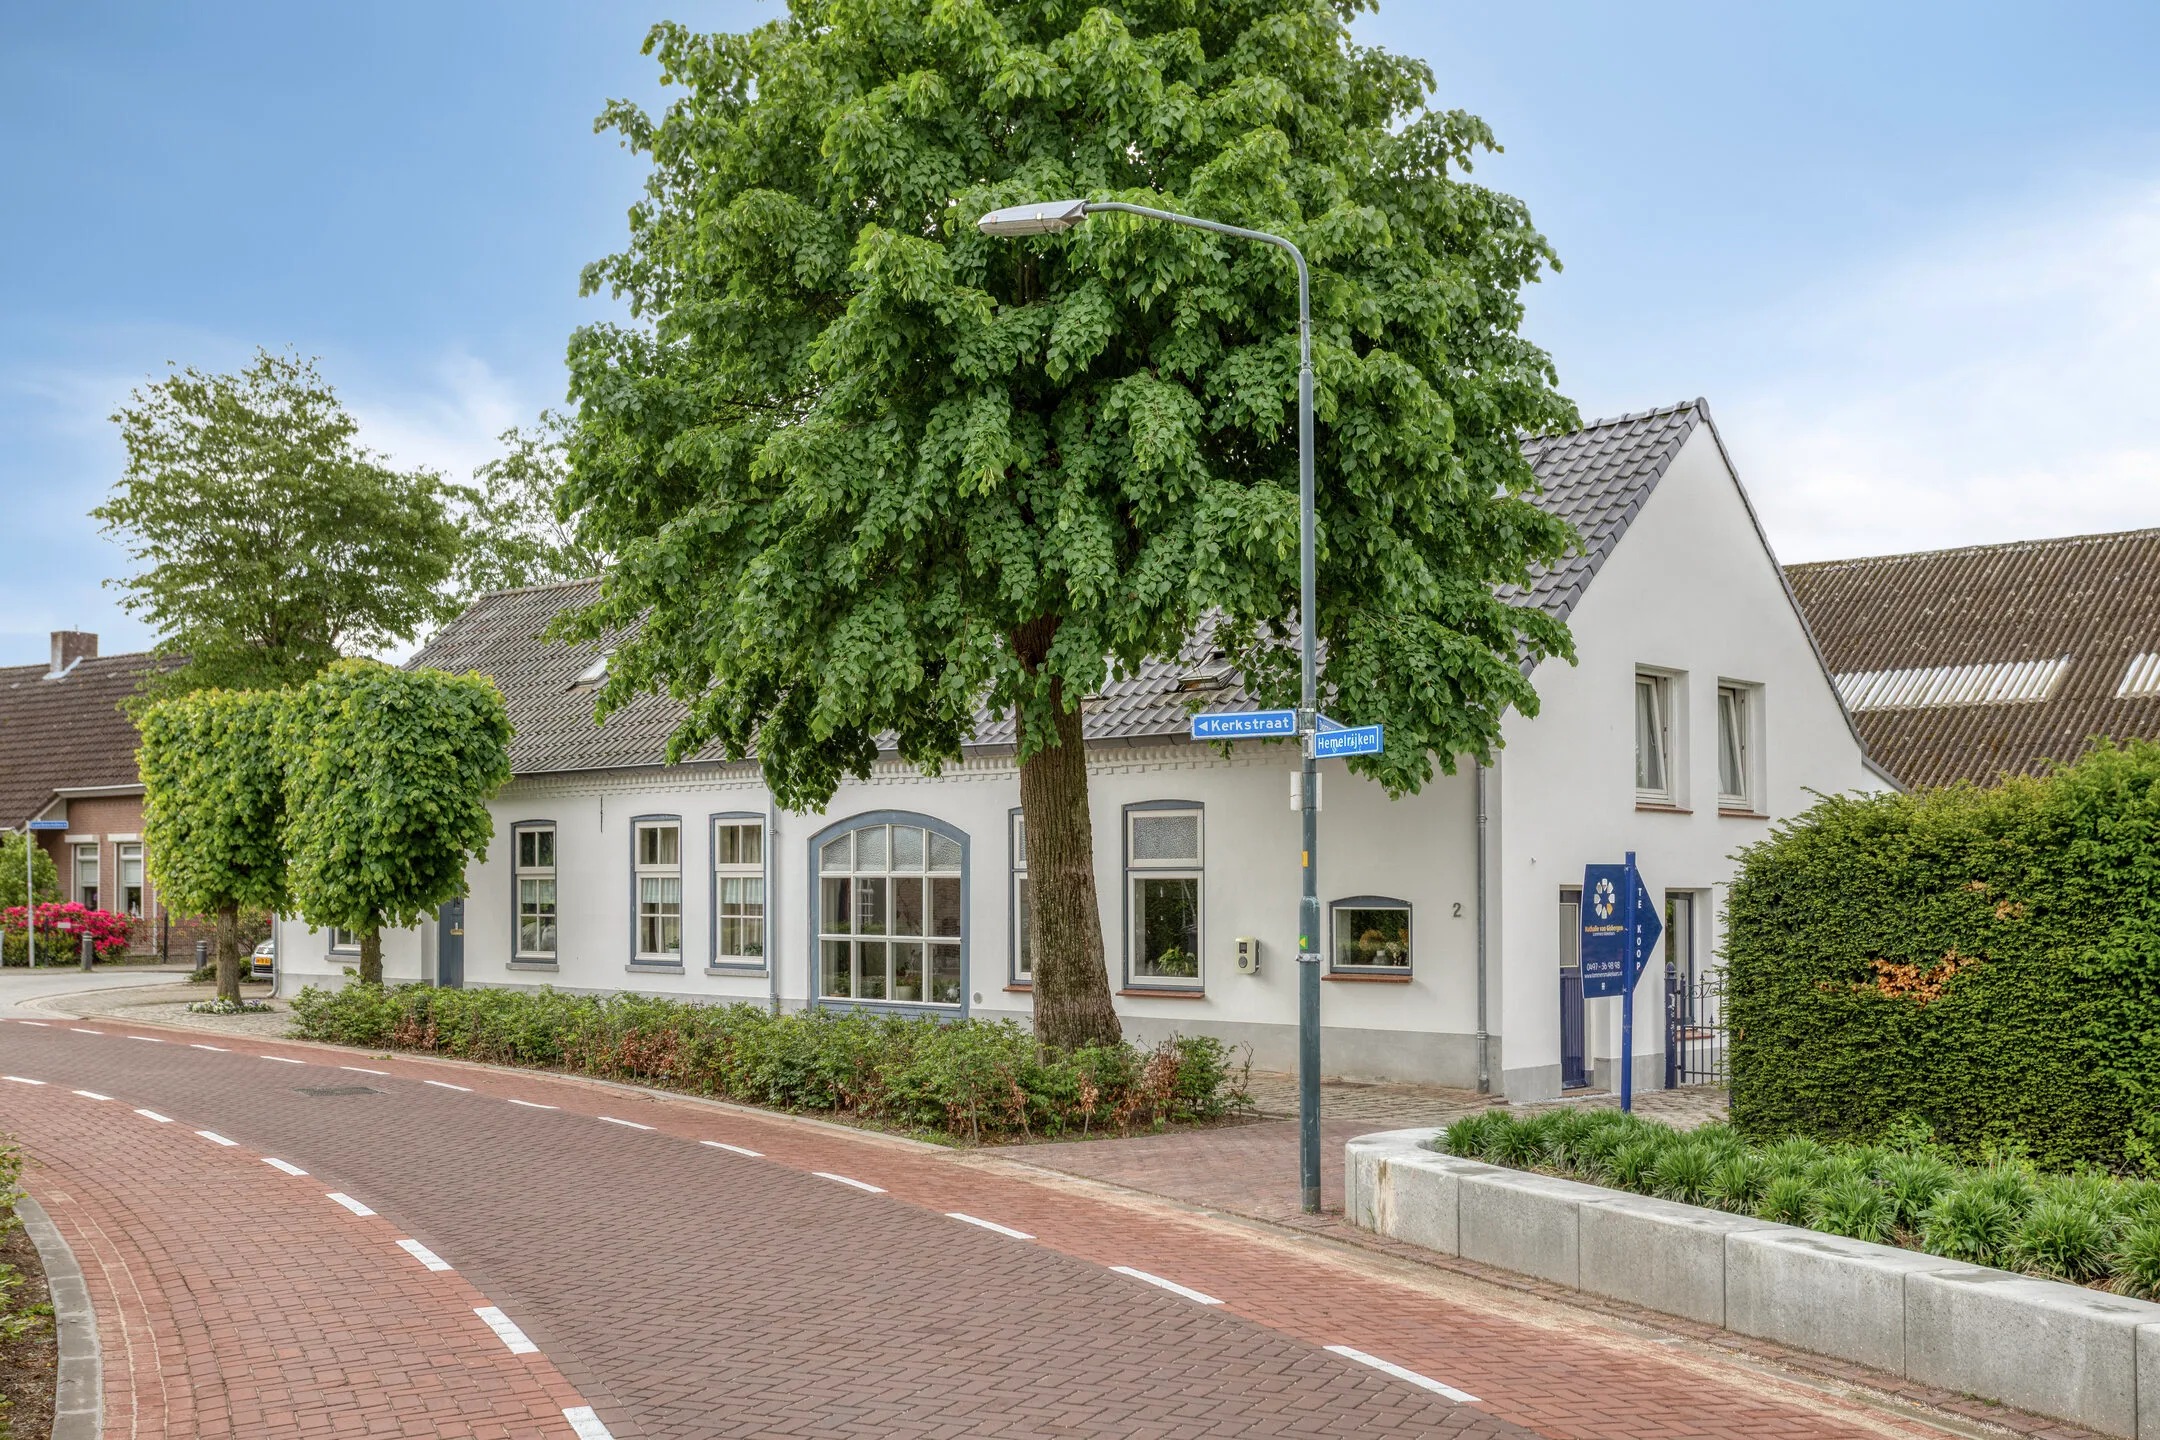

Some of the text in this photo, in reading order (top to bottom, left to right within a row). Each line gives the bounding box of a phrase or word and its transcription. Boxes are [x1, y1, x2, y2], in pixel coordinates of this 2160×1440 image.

[1211, 717, 1289, 732] Kerkstraat
[1318, 733, 1375, 749] Hemelrijken
[1637, 887, 1643, 909] TE
[1453, 902, 1462, 918] 2
[1586, 962, 1599, 971] 0497
[1601, 962, 1608, 970] 36
